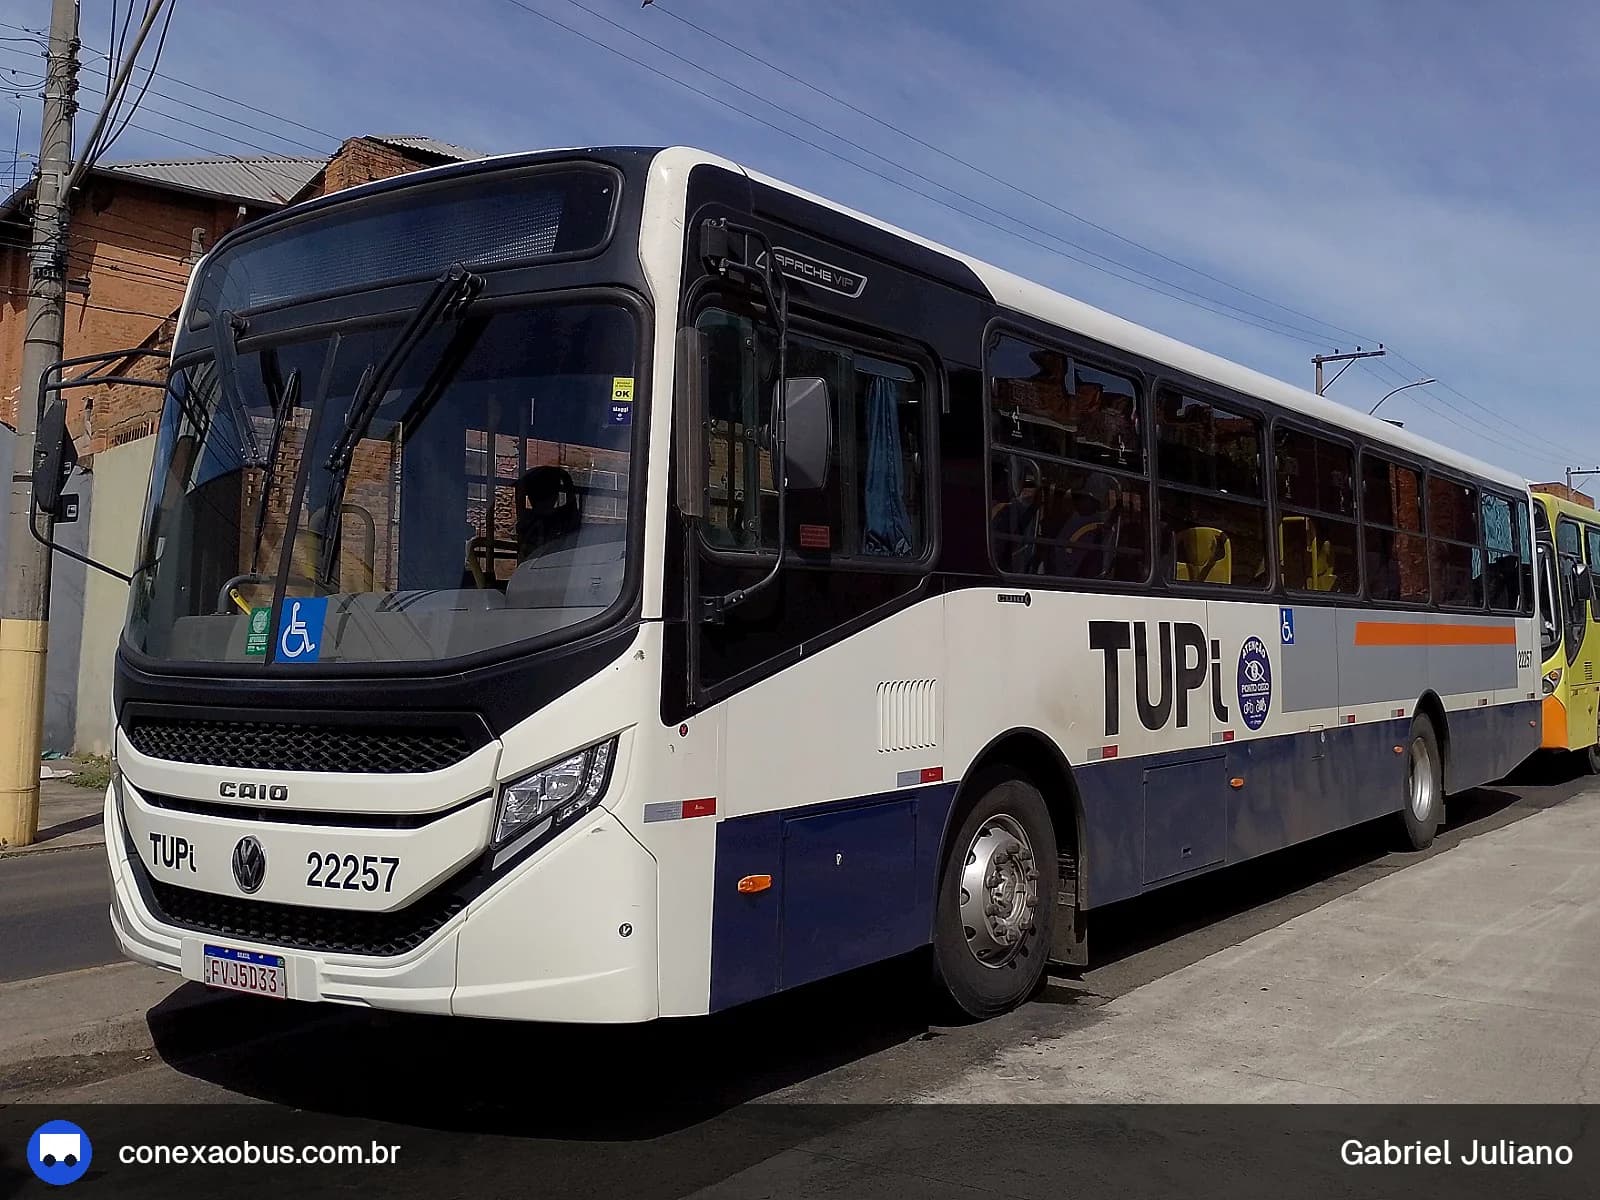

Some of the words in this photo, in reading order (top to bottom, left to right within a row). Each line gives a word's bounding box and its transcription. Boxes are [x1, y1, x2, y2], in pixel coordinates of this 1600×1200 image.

[774, 254, 832, 282] APACHE
[833, 272, 854, 287] VIP
[615, 390, 630, 398] OK
[1518, 650, 1532, 668] 22257
[219, 781, 288, 801] CAIO
[306, 852, 400, 893] 22257
[211, 959, 277, 993] FVJ5D33
